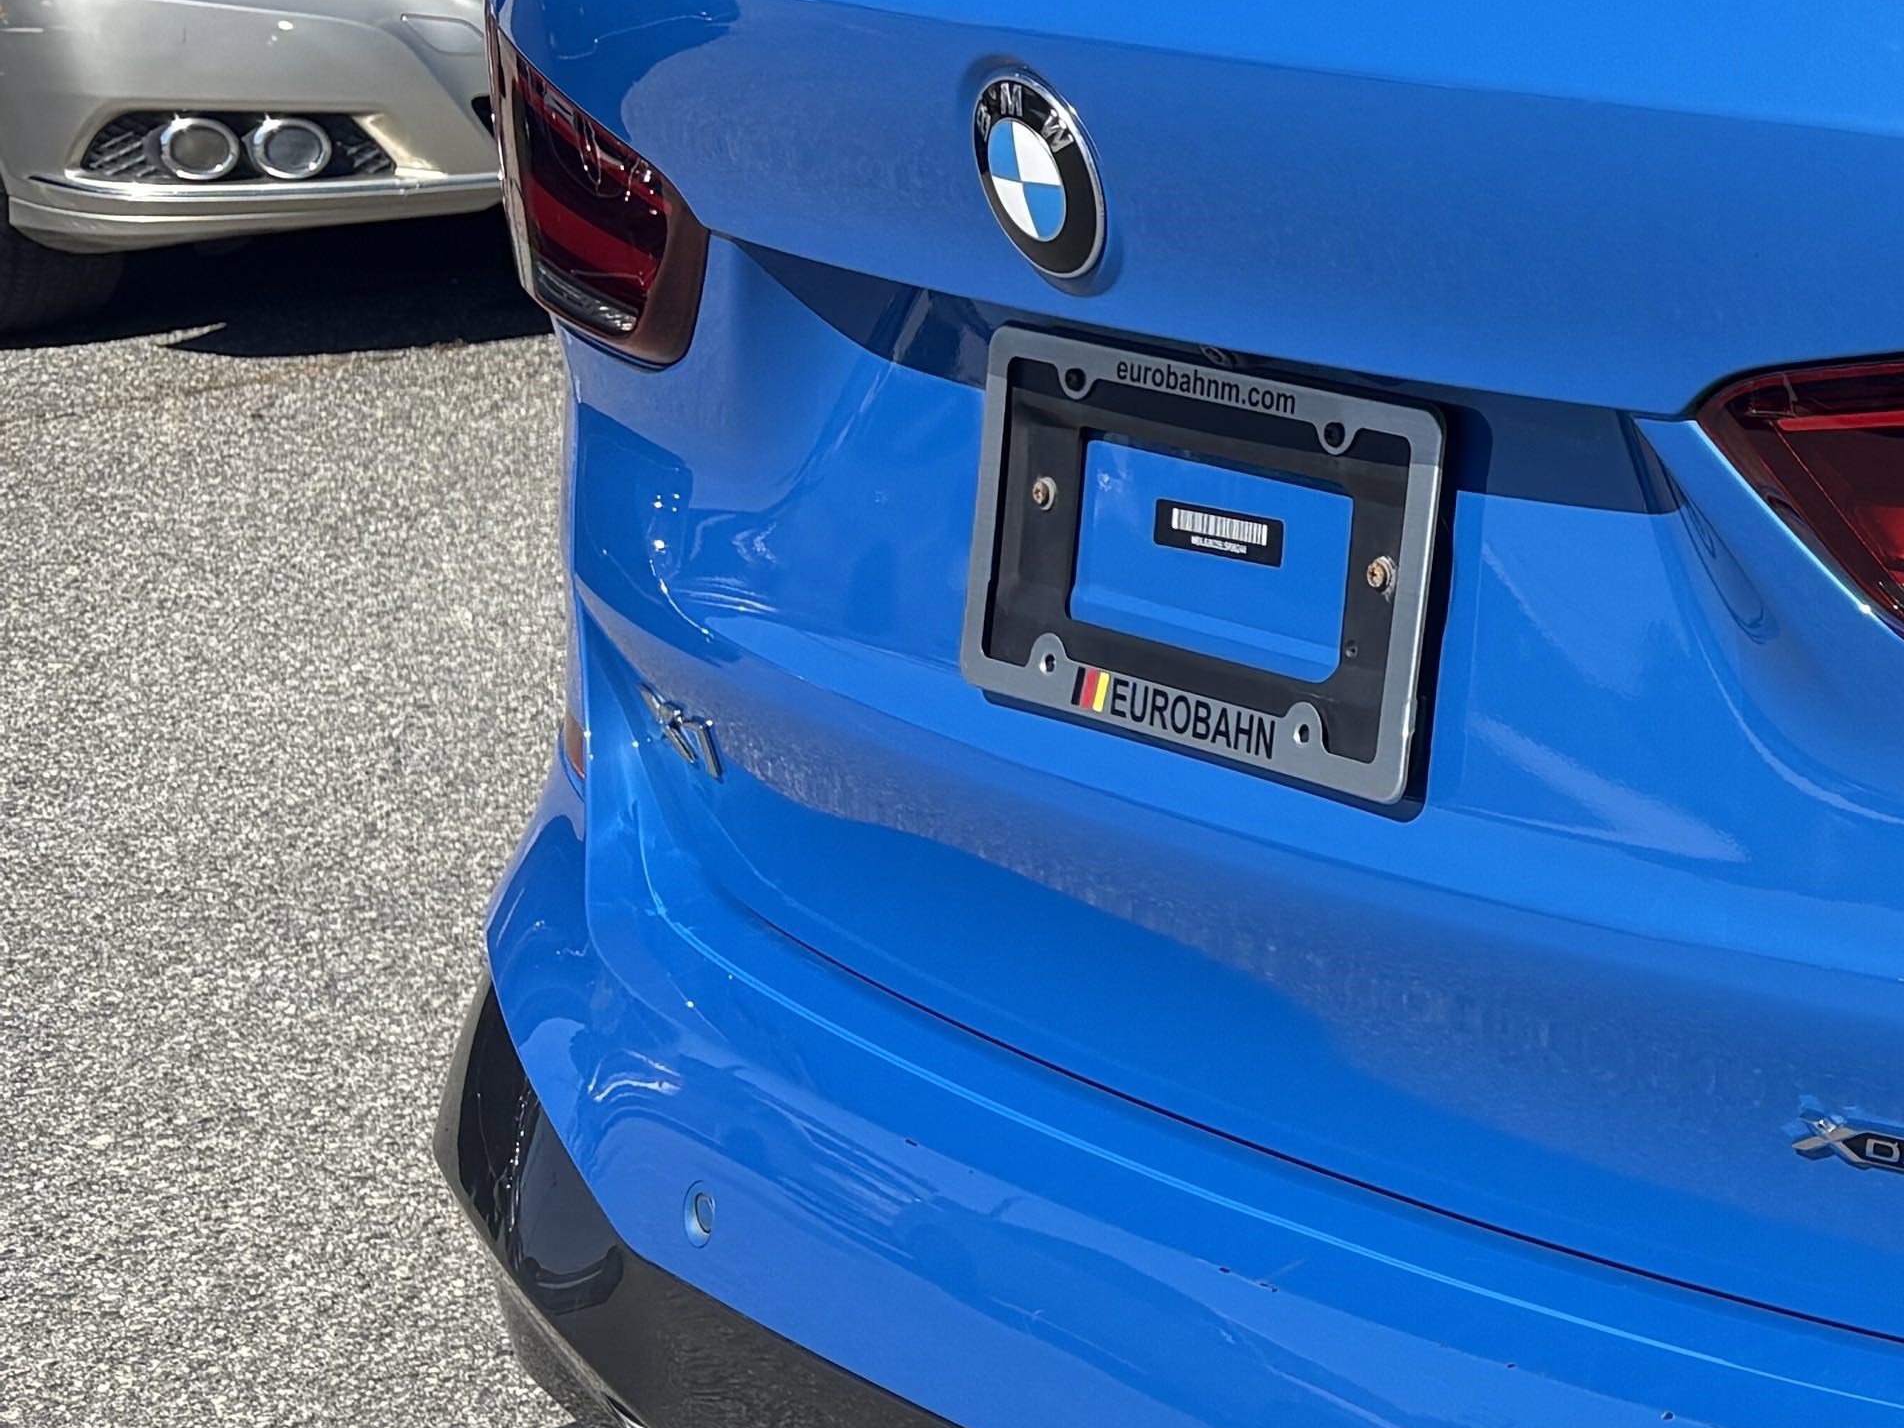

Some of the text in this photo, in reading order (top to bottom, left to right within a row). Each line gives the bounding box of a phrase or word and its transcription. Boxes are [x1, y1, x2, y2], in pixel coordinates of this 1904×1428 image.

[976, 82, 1075, 153] BMW
[1116, 360, 1296, 414] eurobahnm.com
[1110, 677, 1276, 760] EUROBAHN
